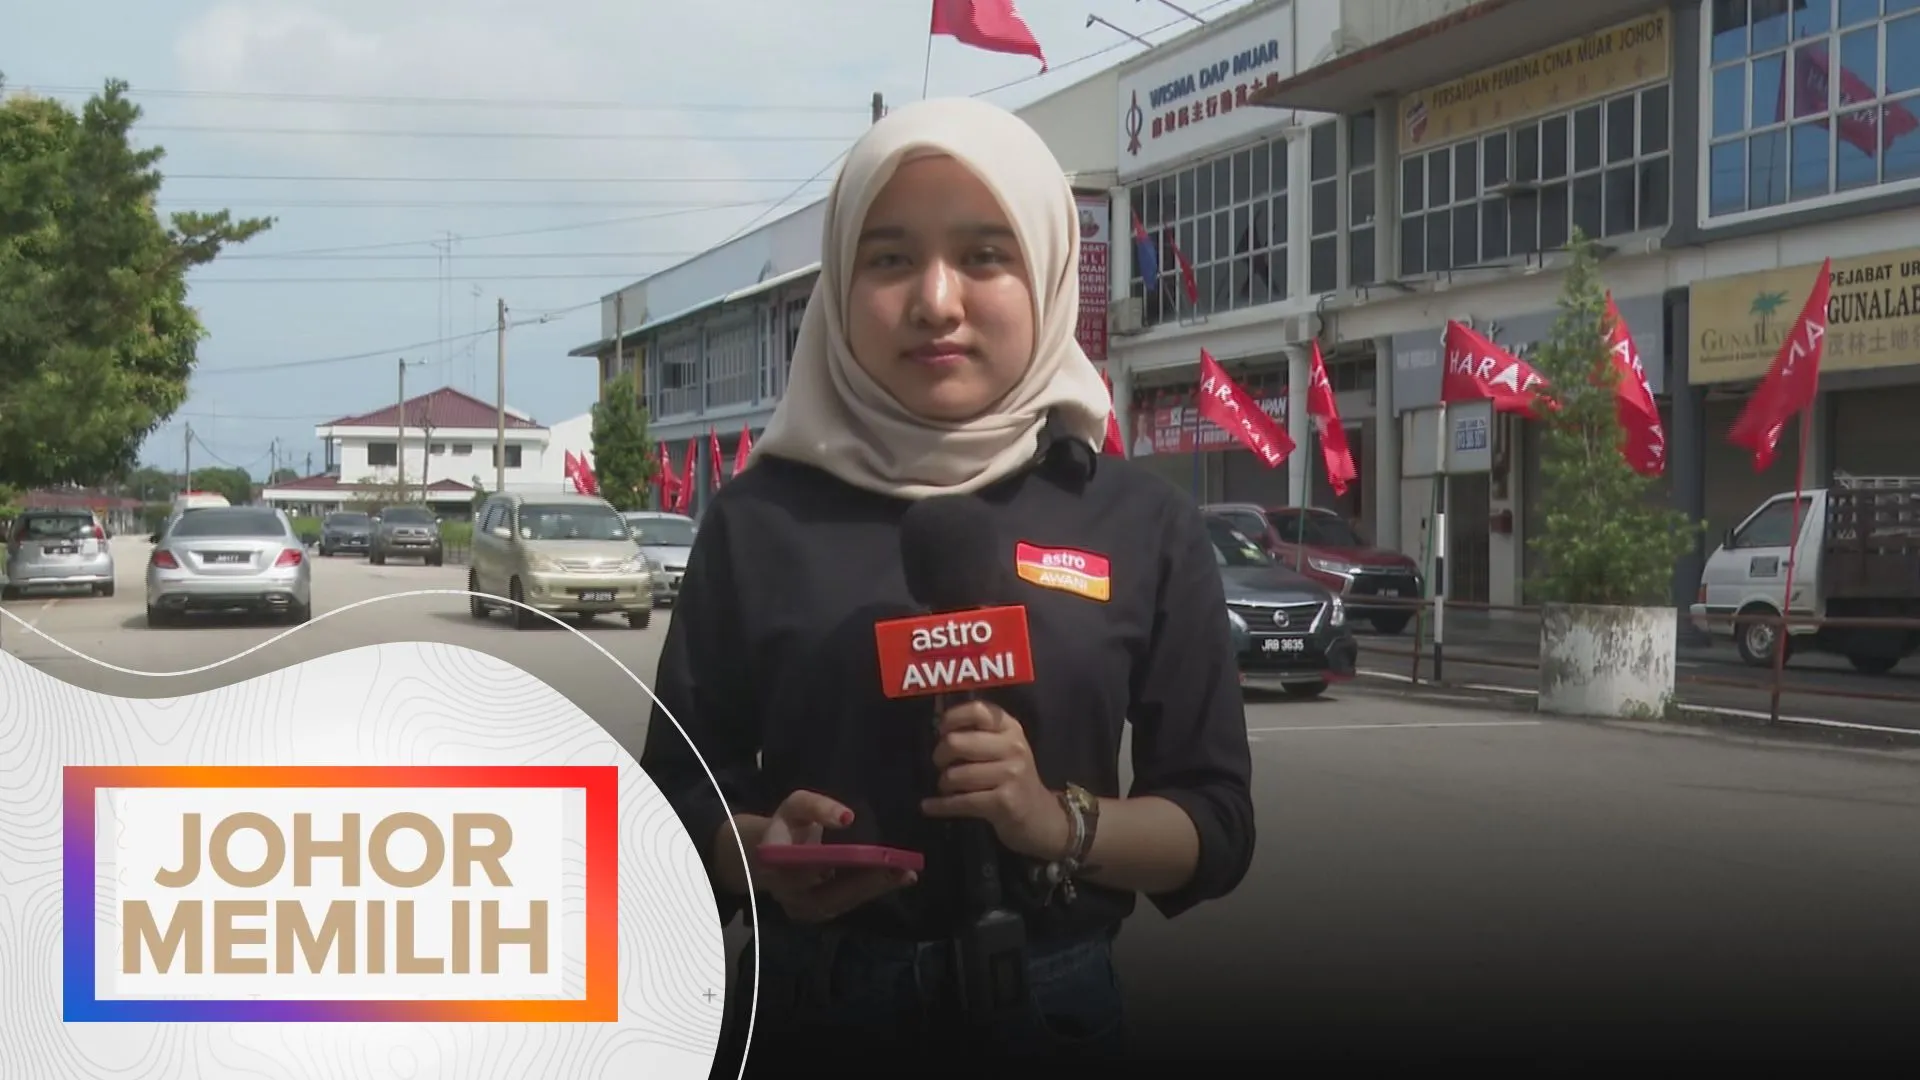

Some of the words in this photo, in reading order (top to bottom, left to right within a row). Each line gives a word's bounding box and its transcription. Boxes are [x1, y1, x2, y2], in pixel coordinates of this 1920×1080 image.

[1492, 57, 1540, 91] PEMBINA
[1543, 48, 1573, 76] CINA
[1577, 33, 1612, 64] MUAR
[1619, 17, 1664, 50] JOHOR
[1149, 74, 1196, 110] WISMA
[1199, 61, 1230, 90] DAP
[1233, 39, 1279, 77] MUAR
[1829, 263, 1893, 288] PEJABAT
[1041, 552, 1086, 569] astro
[1039, 571, 1088, 591] AWANI
[911, 619, 993, 652] astro
[902, 651, 1016, 691] AWANI
